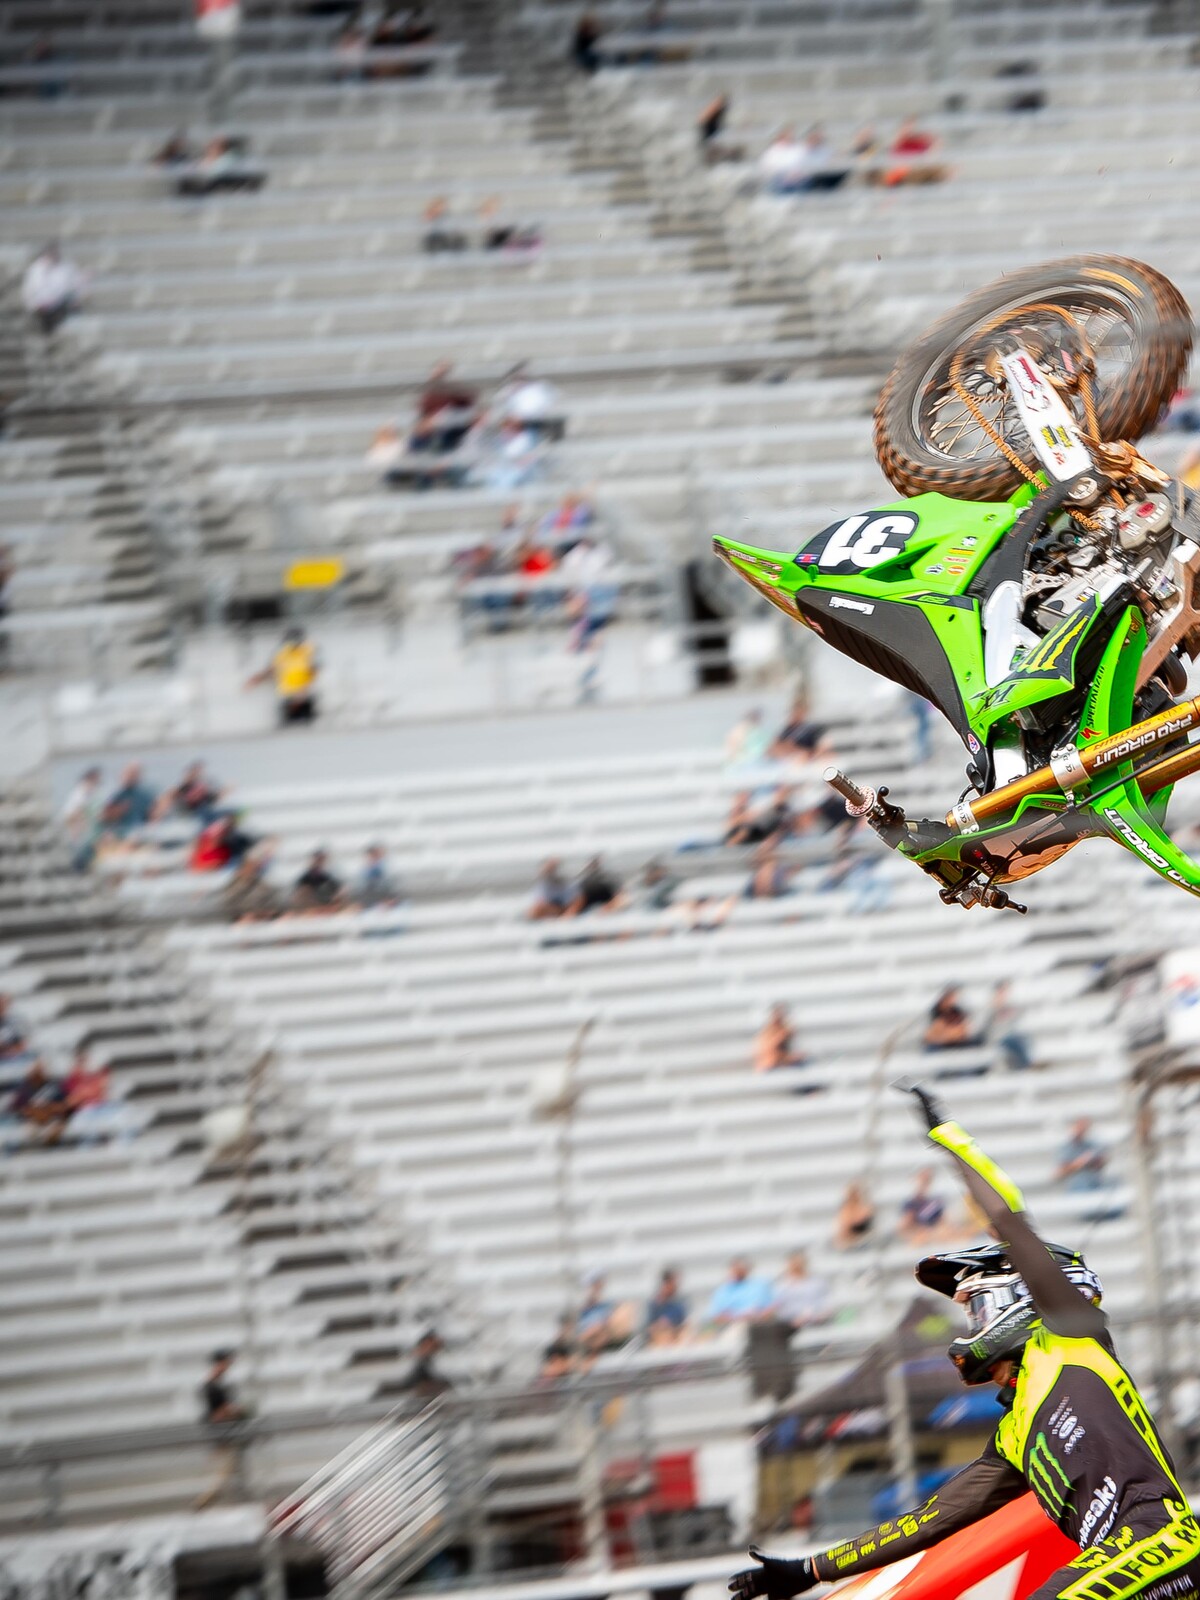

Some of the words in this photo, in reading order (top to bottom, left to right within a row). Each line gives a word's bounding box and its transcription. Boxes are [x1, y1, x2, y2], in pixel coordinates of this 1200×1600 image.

[818, 515, 916, 568] 31
[1157, 713, 1193, 742] PRO
[1093, 731, 1156, 768] CIRCUIT
[1104, 807, 1170, 868] CIRCUIT
[1119, 1541, 1183, 1580] FOX
